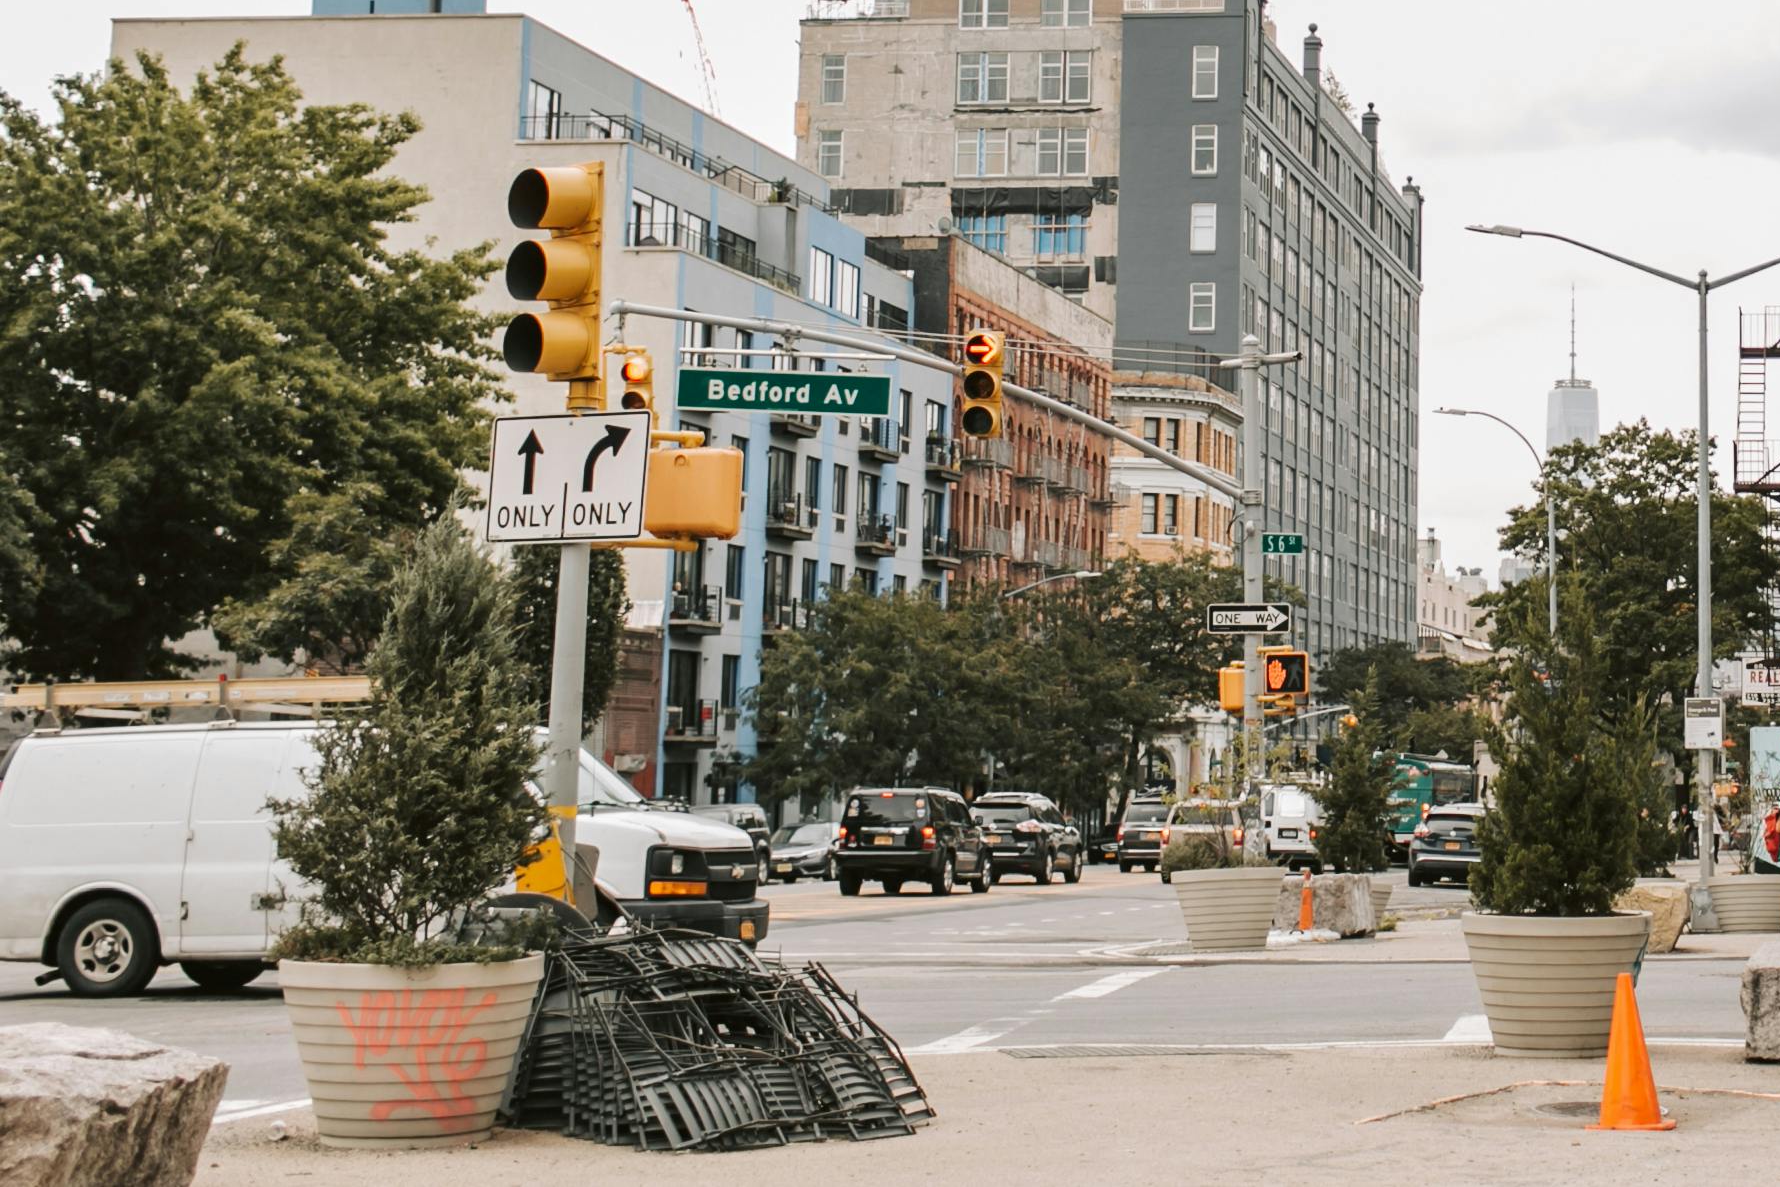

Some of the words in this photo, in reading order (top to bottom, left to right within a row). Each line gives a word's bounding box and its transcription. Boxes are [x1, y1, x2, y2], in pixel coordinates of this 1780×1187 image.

[707, 379, 810, 404] Bedford
[823, 383, 859, 406] Av
[497, 503, 556, 529] ONLY
[572, 501, 633, 526] ONLY
[1267, 535, 1274, 552] S
[1278, 535, 1285, 552] 6
[1215, 613, 1241, 624] ONE
[1255, 613, 1280, 624] WAY
